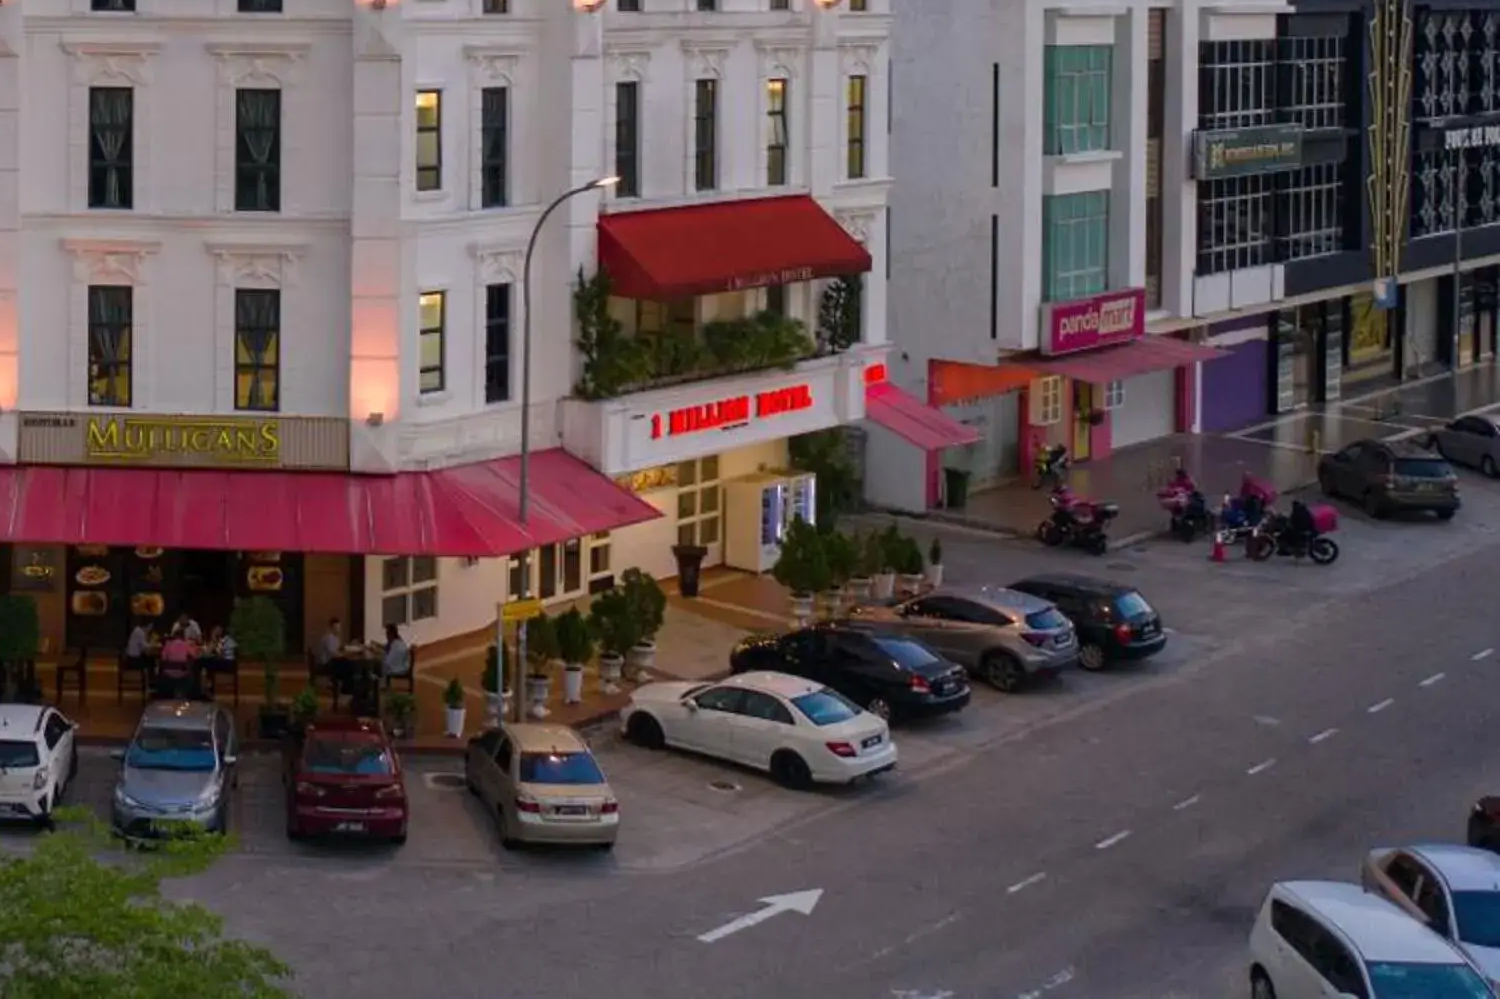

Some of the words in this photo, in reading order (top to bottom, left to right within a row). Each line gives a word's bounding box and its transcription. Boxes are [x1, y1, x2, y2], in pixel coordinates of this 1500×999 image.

[669, 395, 750, 436] MILLION
[756, 384, 813, 418] HOTEL
[87, 419, 279, 452] MULLIGANS
